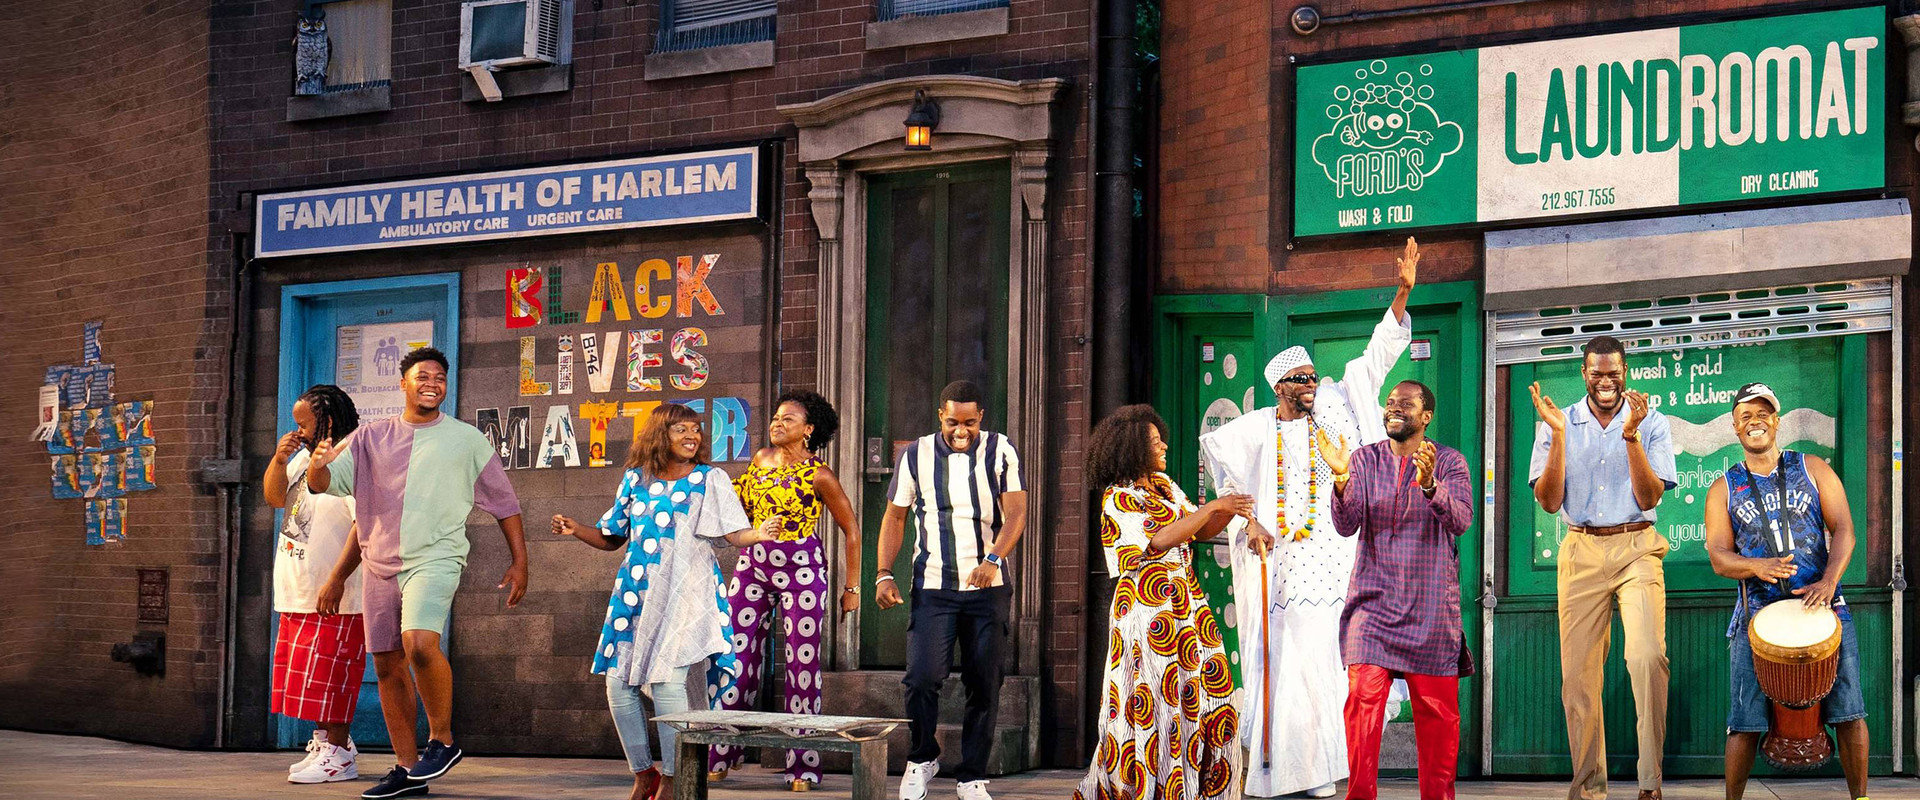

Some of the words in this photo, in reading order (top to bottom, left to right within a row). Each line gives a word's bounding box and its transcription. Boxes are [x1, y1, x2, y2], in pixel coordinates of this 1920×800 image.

[1504, 36, 1879, 165] LAUNDROMAT
[1336, 148, 1424, 198] FORD'S
[1741, 173, 1763, 195] DRY
[1768, 169, 1819, 191] CLEANING
[277, 194, 392, 231] FAMILY
[401, 181, 525, 220] HEALTH
[536, 176, 582, 208] OF
[592, 161, 737, 203] HARLEM
[1541, 187, 1616, 212] 212.967.7555
[379, 219, 471, 239] AMBULATORY
[473, 216, 510, 232] CARE
[527, 210, 583, 227] URGENT
[586, 207, 623, 222] CARE
[1338, 208, 1367, 228] WASH
[1372, 207, 1382, 225] &
[1387, 205, 1413, 224] FOLD
[505, 253, 726, 329] BLACK
[520, 327, 710, 396] LIVES
[582, 335, 600, 375] 8:46
[1630, 357, 1667, 380] wash
[1674, 362, 1683, 378] &
[1690, 352, 1723, 382] fold
[357, 407, 384, 416] EALTH
[1669, 391, 1678, 407] &
[1206, 416, 1222, 432] open
